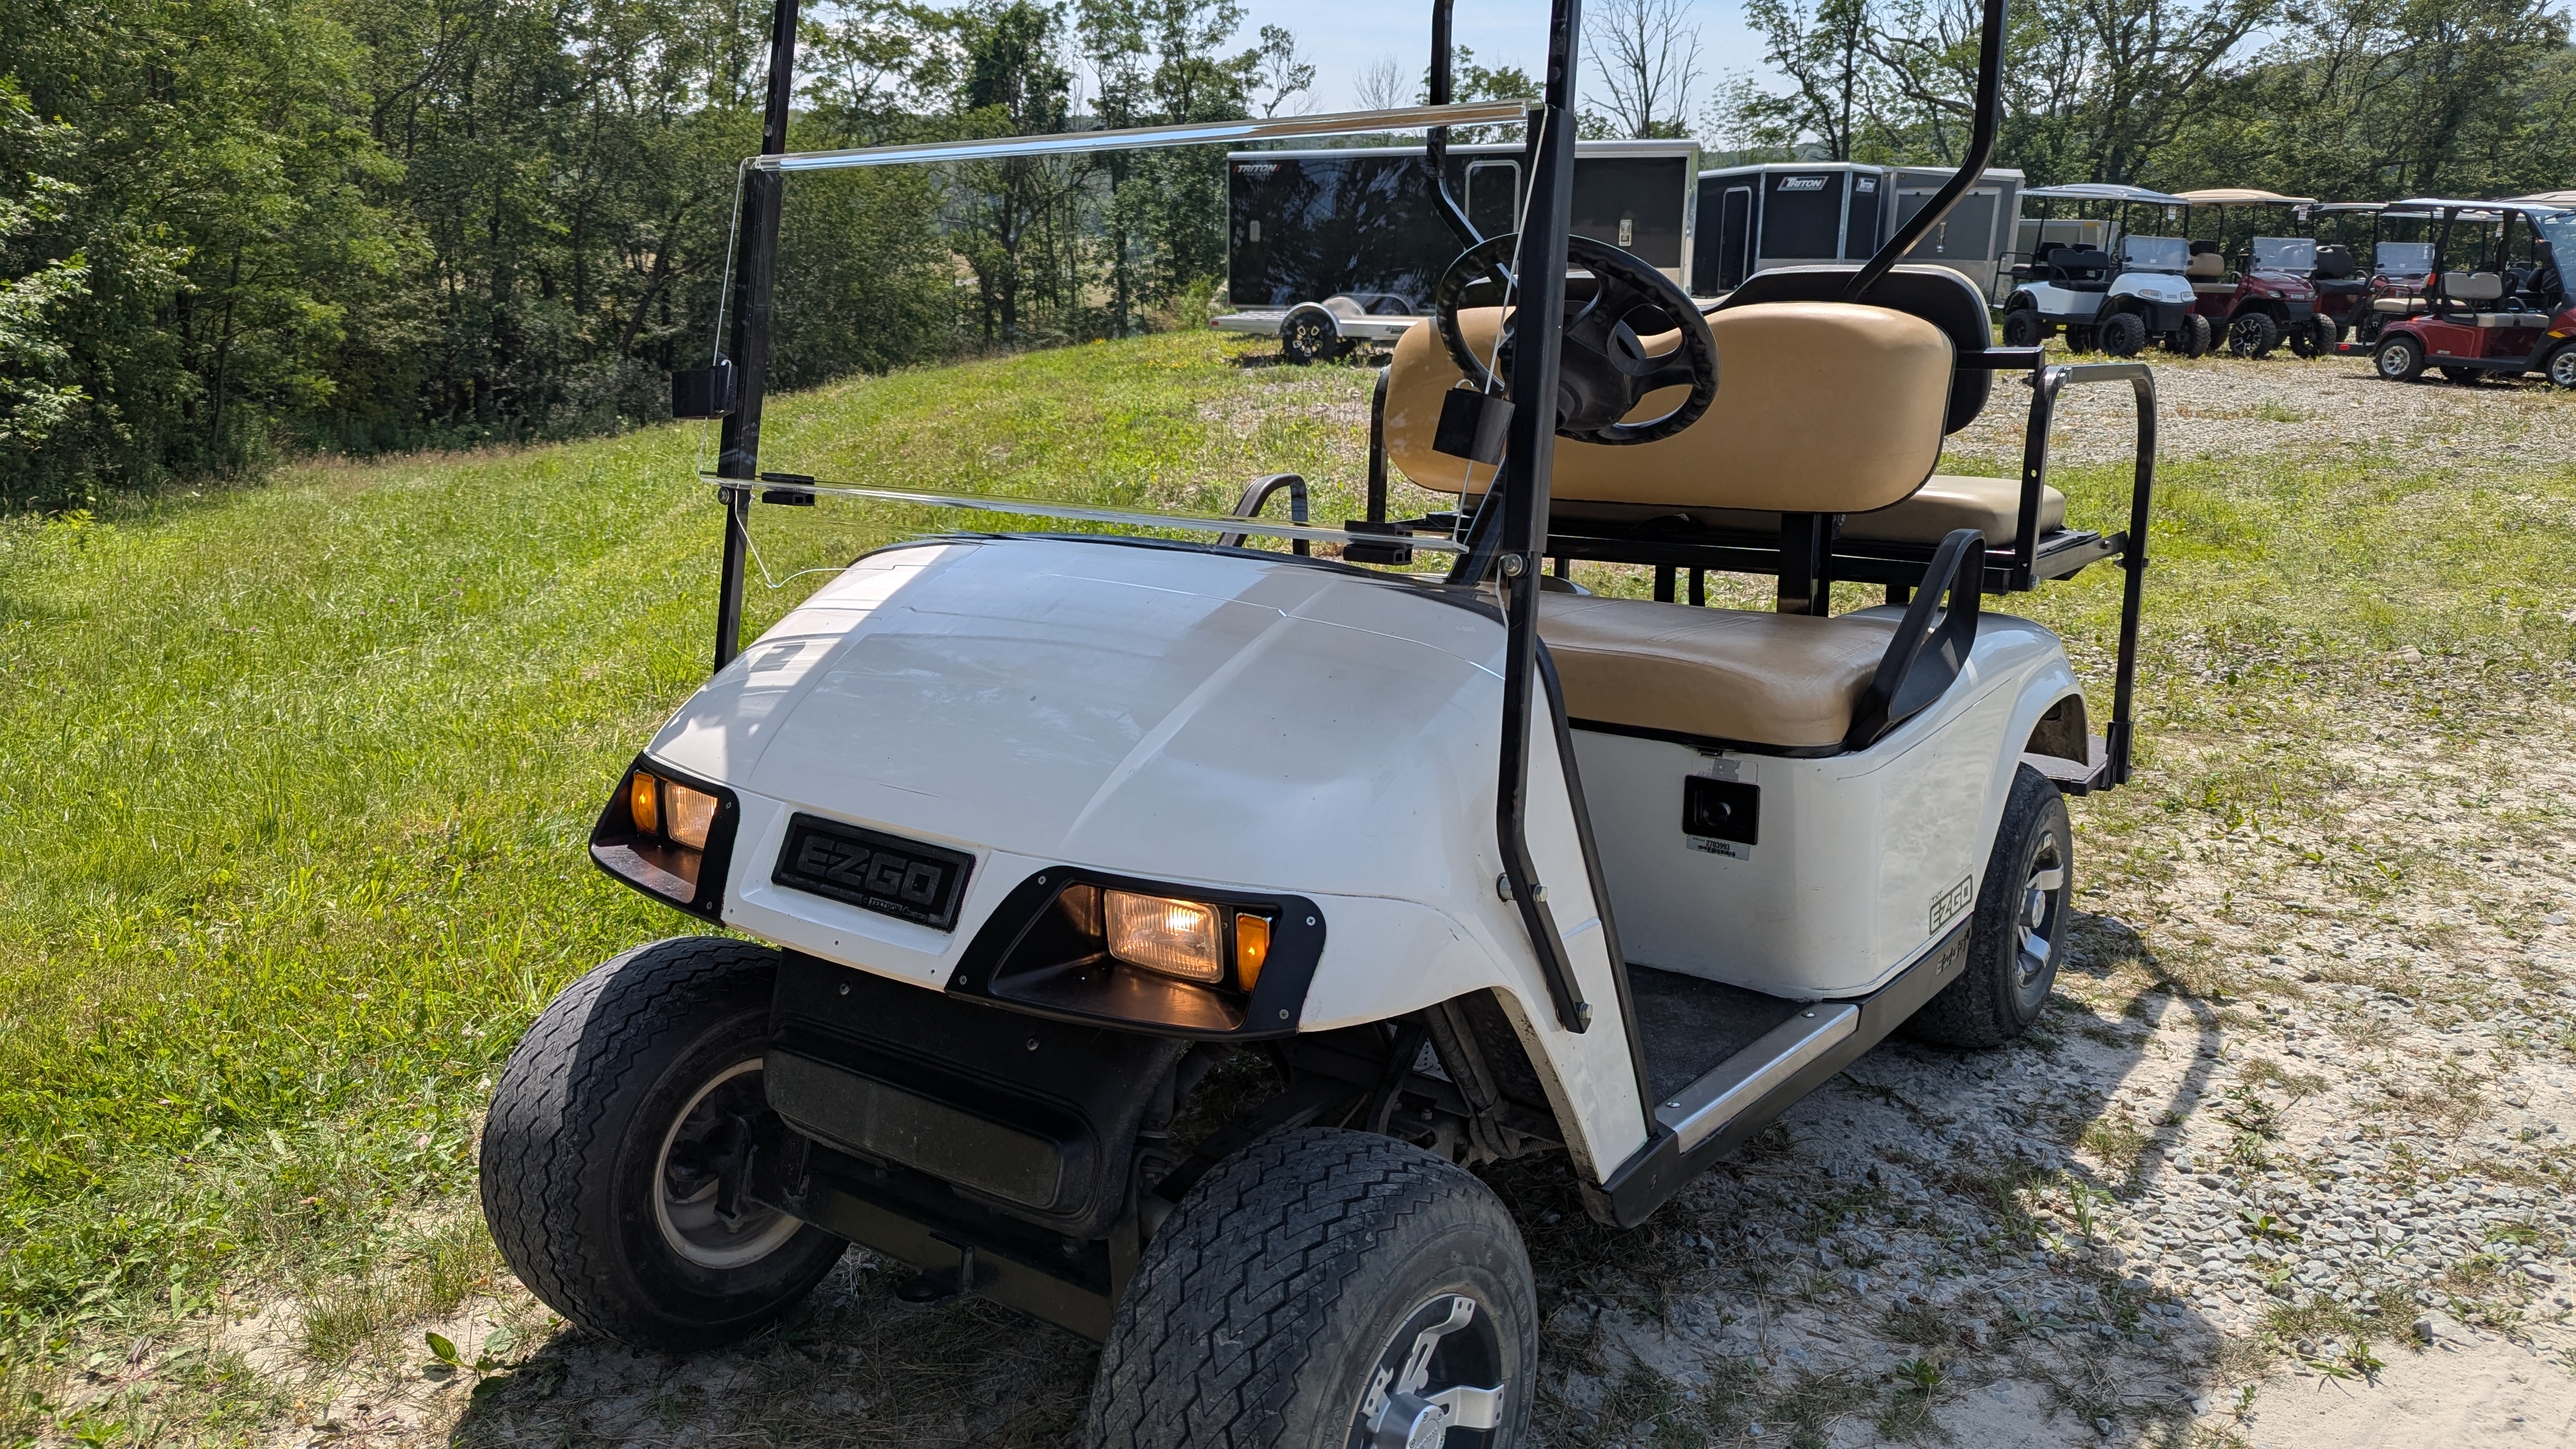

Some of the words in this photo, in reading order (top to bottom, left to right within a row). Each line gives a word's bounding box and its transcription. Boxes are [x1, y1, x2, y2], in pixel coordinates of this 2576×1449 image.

[1238, 164, 1277, 173] TRITON
[1786, 178, 1822, 187] TRITON
[1706, 839, 1730, 851] 2703993
[796, 835, 943, 906] EZGO
[1931, 890, 1943, 904] TXT
[1931, 878, 1971, 932] EZGO
